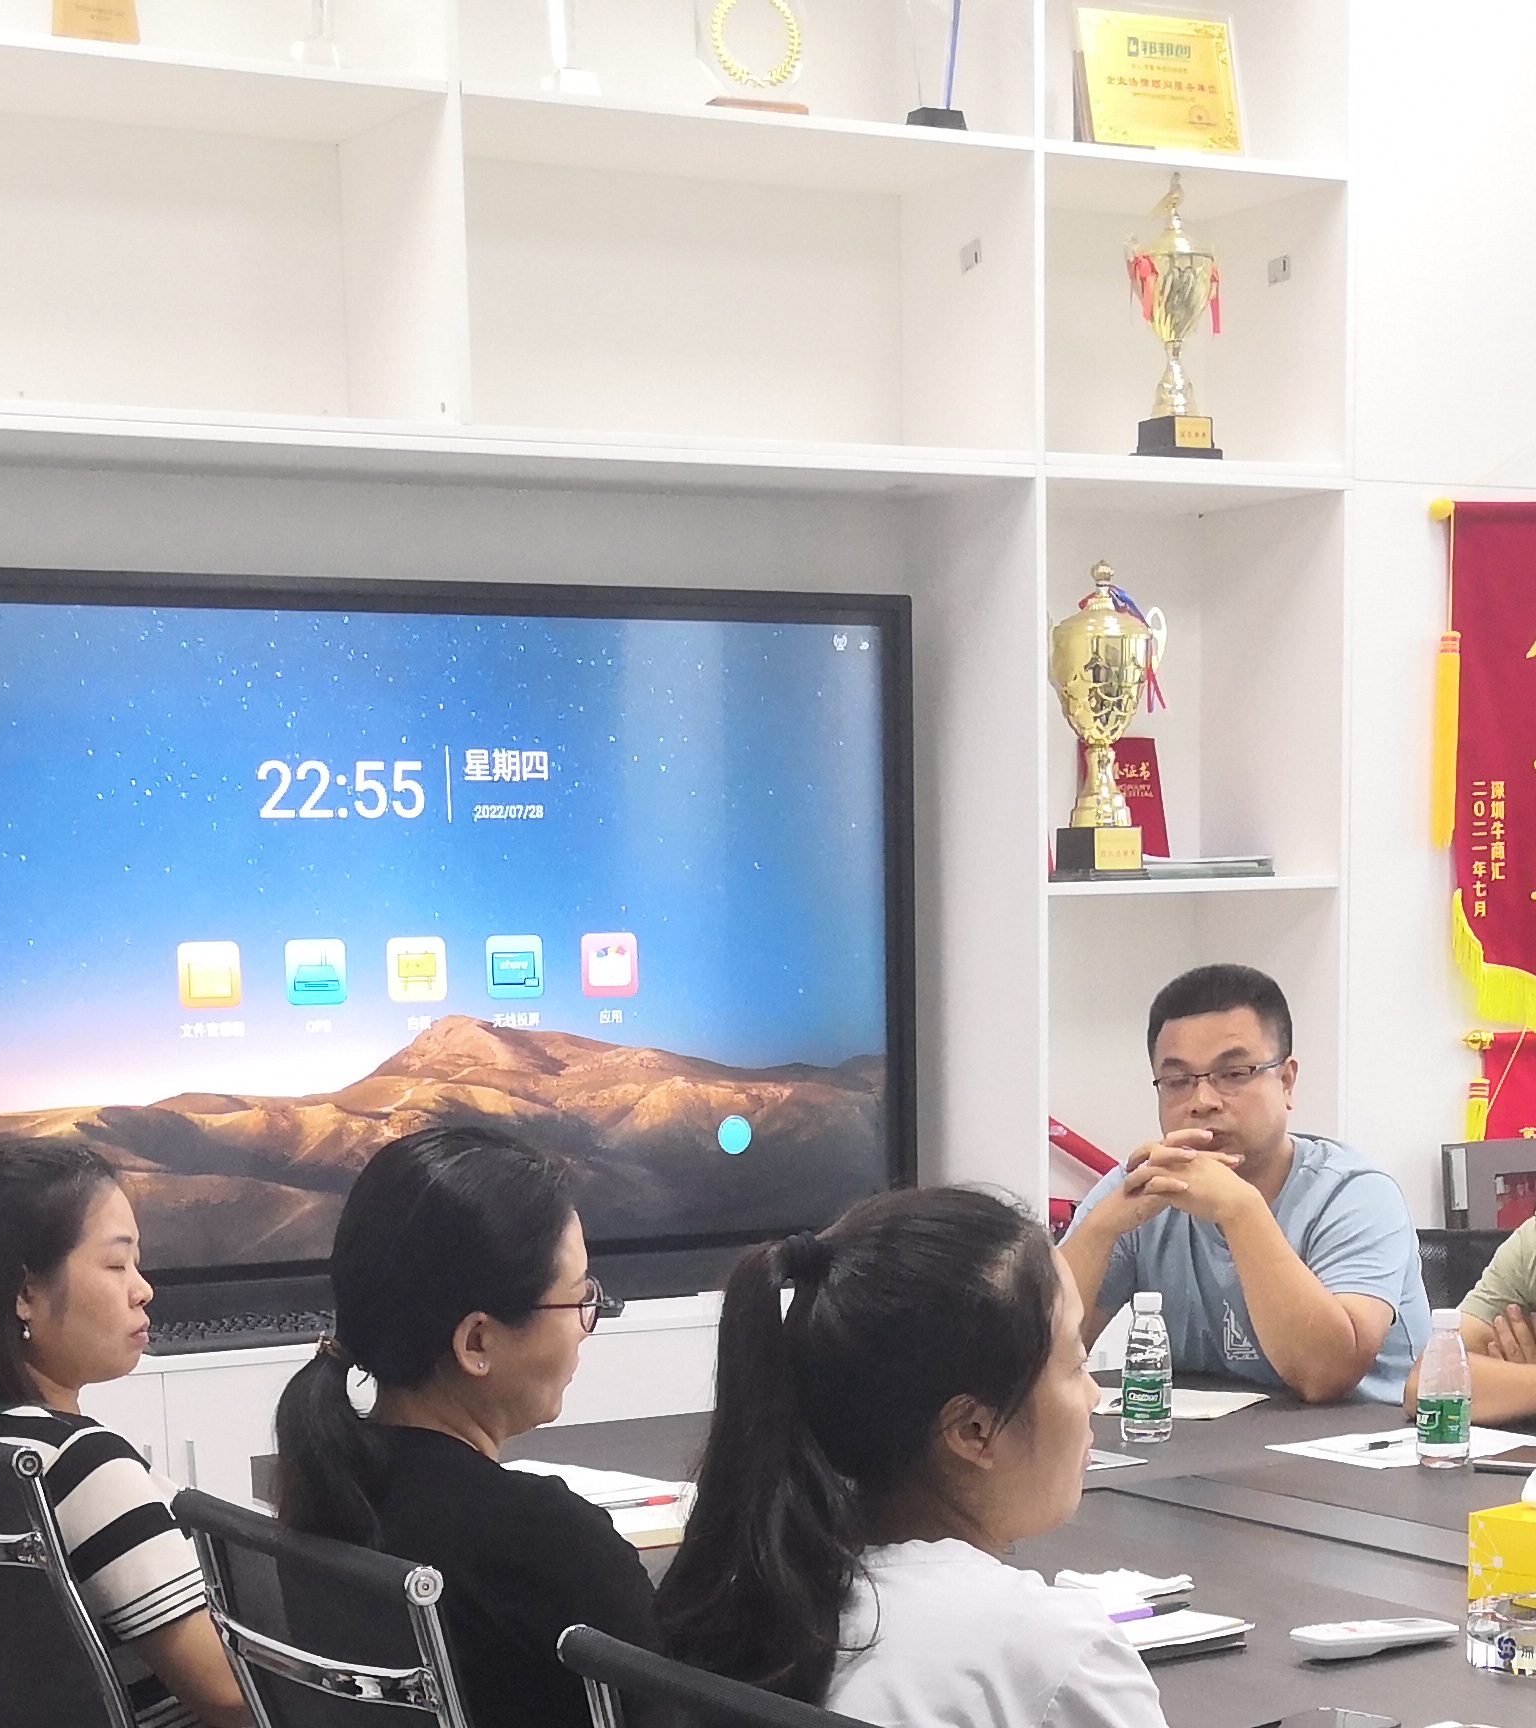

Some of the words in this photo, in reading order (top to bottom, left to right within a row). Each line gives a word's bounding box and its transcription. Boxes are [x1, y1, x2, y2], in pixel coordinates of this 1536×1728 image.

[464, 749, 550, 782] 星期四
[257, 759, 425, 819] 22:55
[474, 804, 545, 820] 2022/07/28
[1490, 780, 1506, 881] 深圳牛商汇
[599, 1009, 623, 1024] 应用
